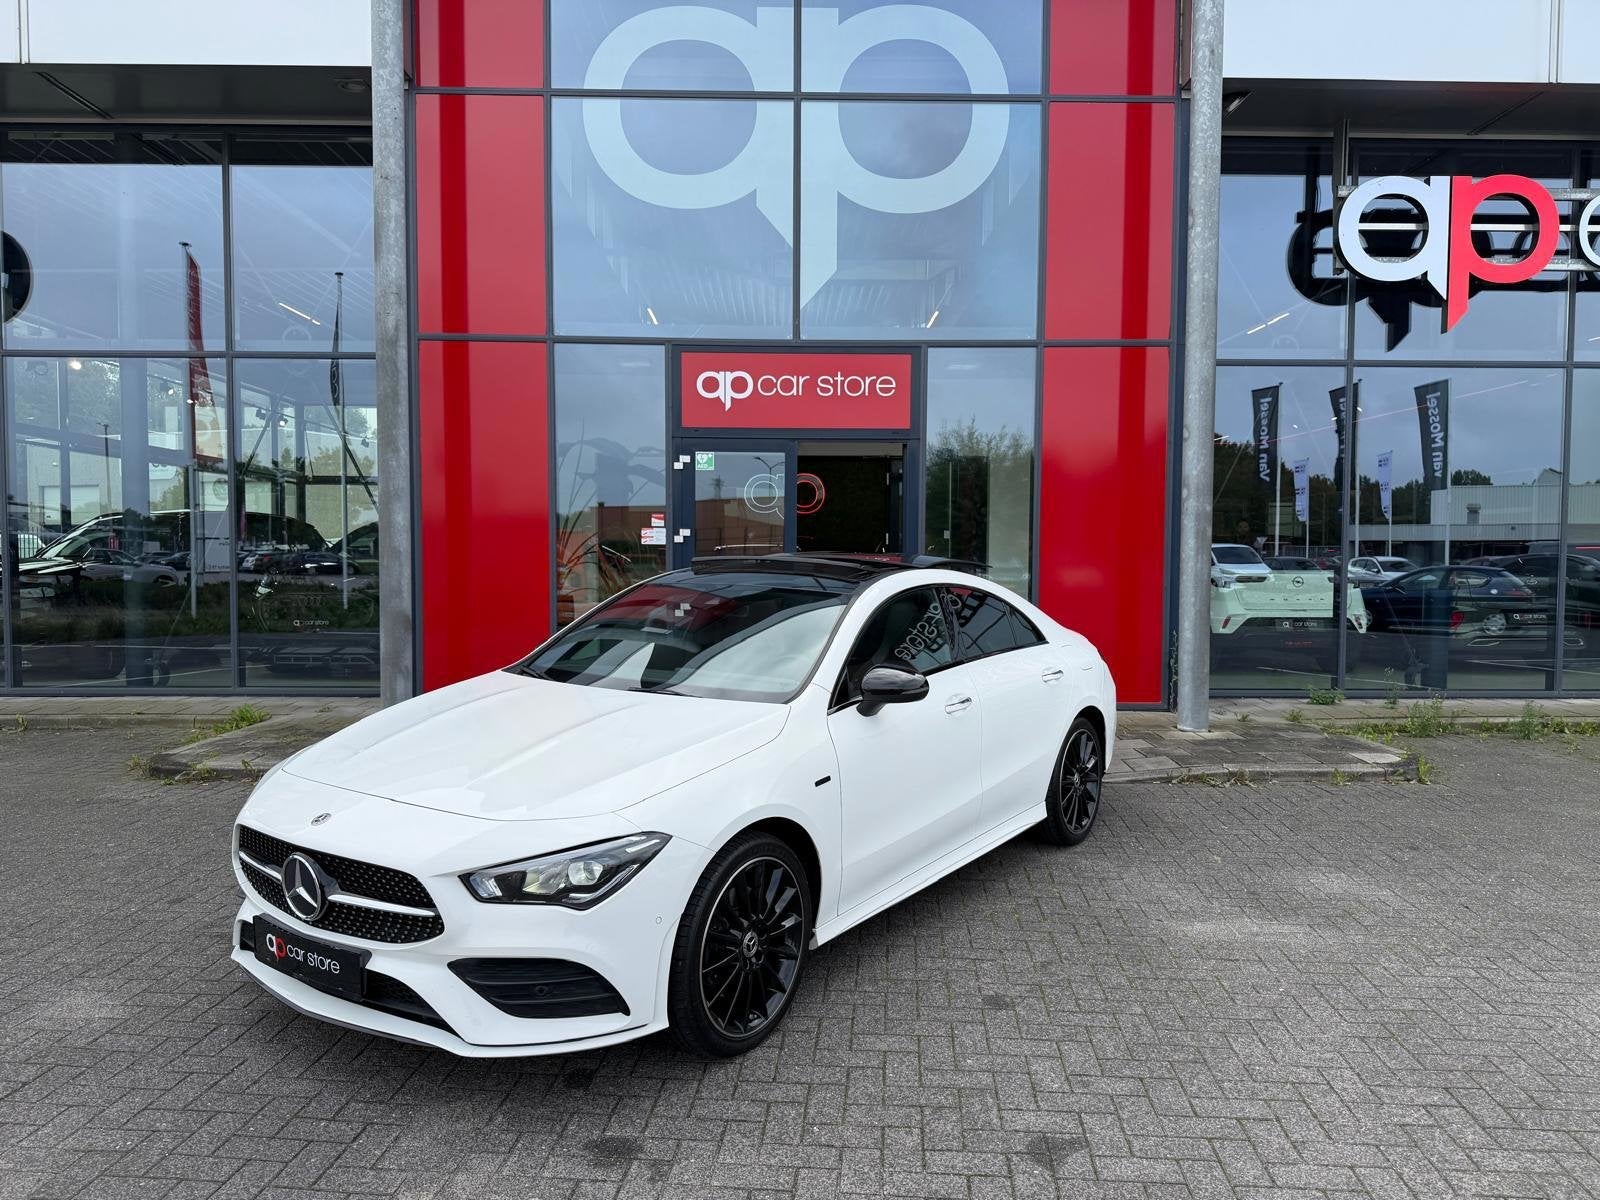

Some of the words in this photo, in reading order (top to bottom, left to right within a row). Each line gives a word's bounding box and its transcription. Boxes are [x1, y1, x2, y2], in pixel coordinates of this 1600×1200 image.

[583, 4, 1010, 310] ap
[1338, 174, 1560, 333] ap
[696, 370, 754, 411] ap
[757, 375, 810, 396] car
[817, 371, 897, 397] store
[266, 933, 287, 961] ap
[287, 945, 305, 962] car
[307, 951, 341, 974] store
